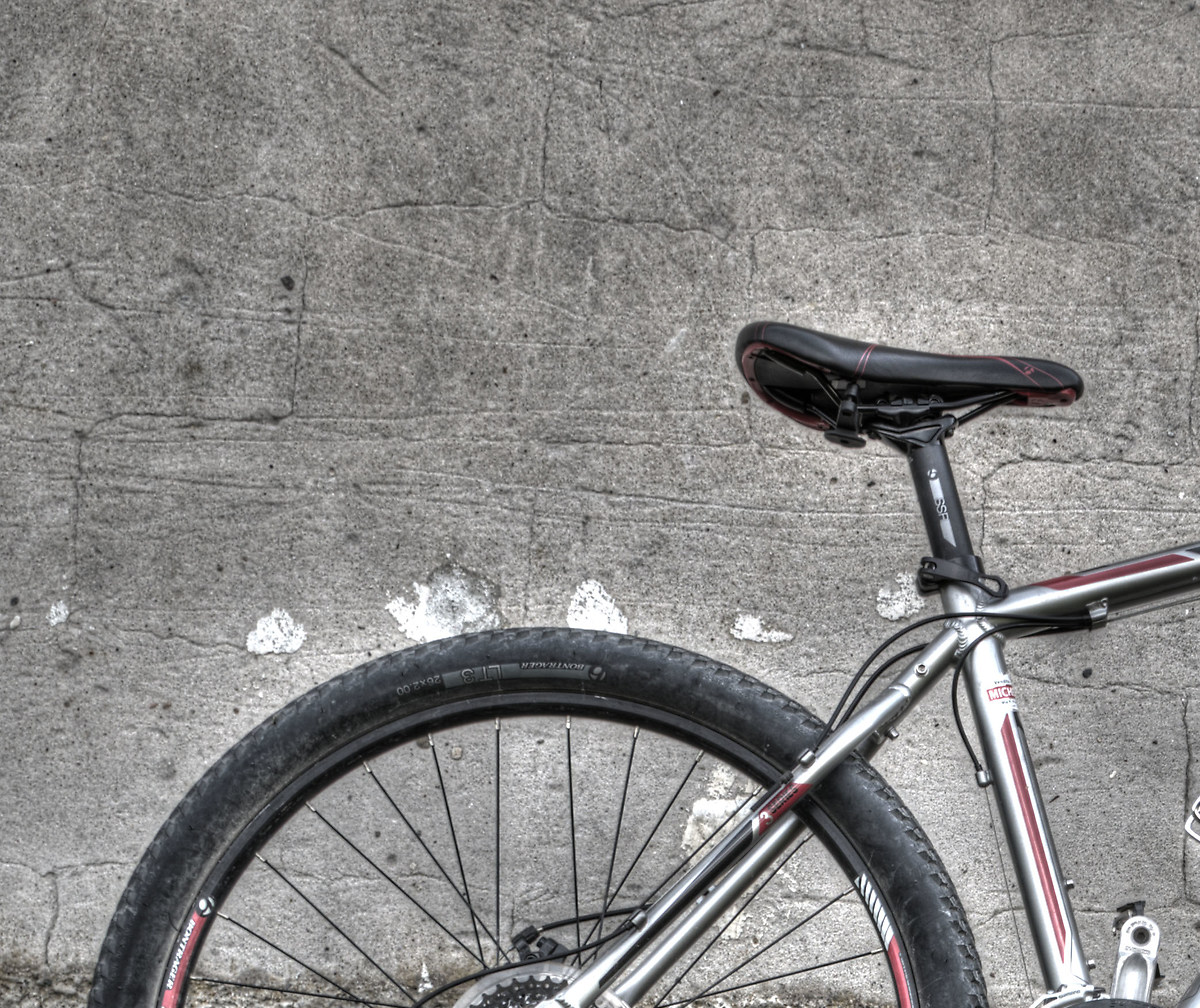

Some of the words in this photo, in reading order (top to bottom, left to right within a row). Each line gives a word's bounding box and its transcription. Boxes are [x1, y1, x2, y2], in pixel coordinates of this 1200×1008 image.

[520, 661, 586, 670] BONTRAGER
[396, 675, 441, 696] 26x2.00
[166, 918, 196, 990] BONTRAGER
